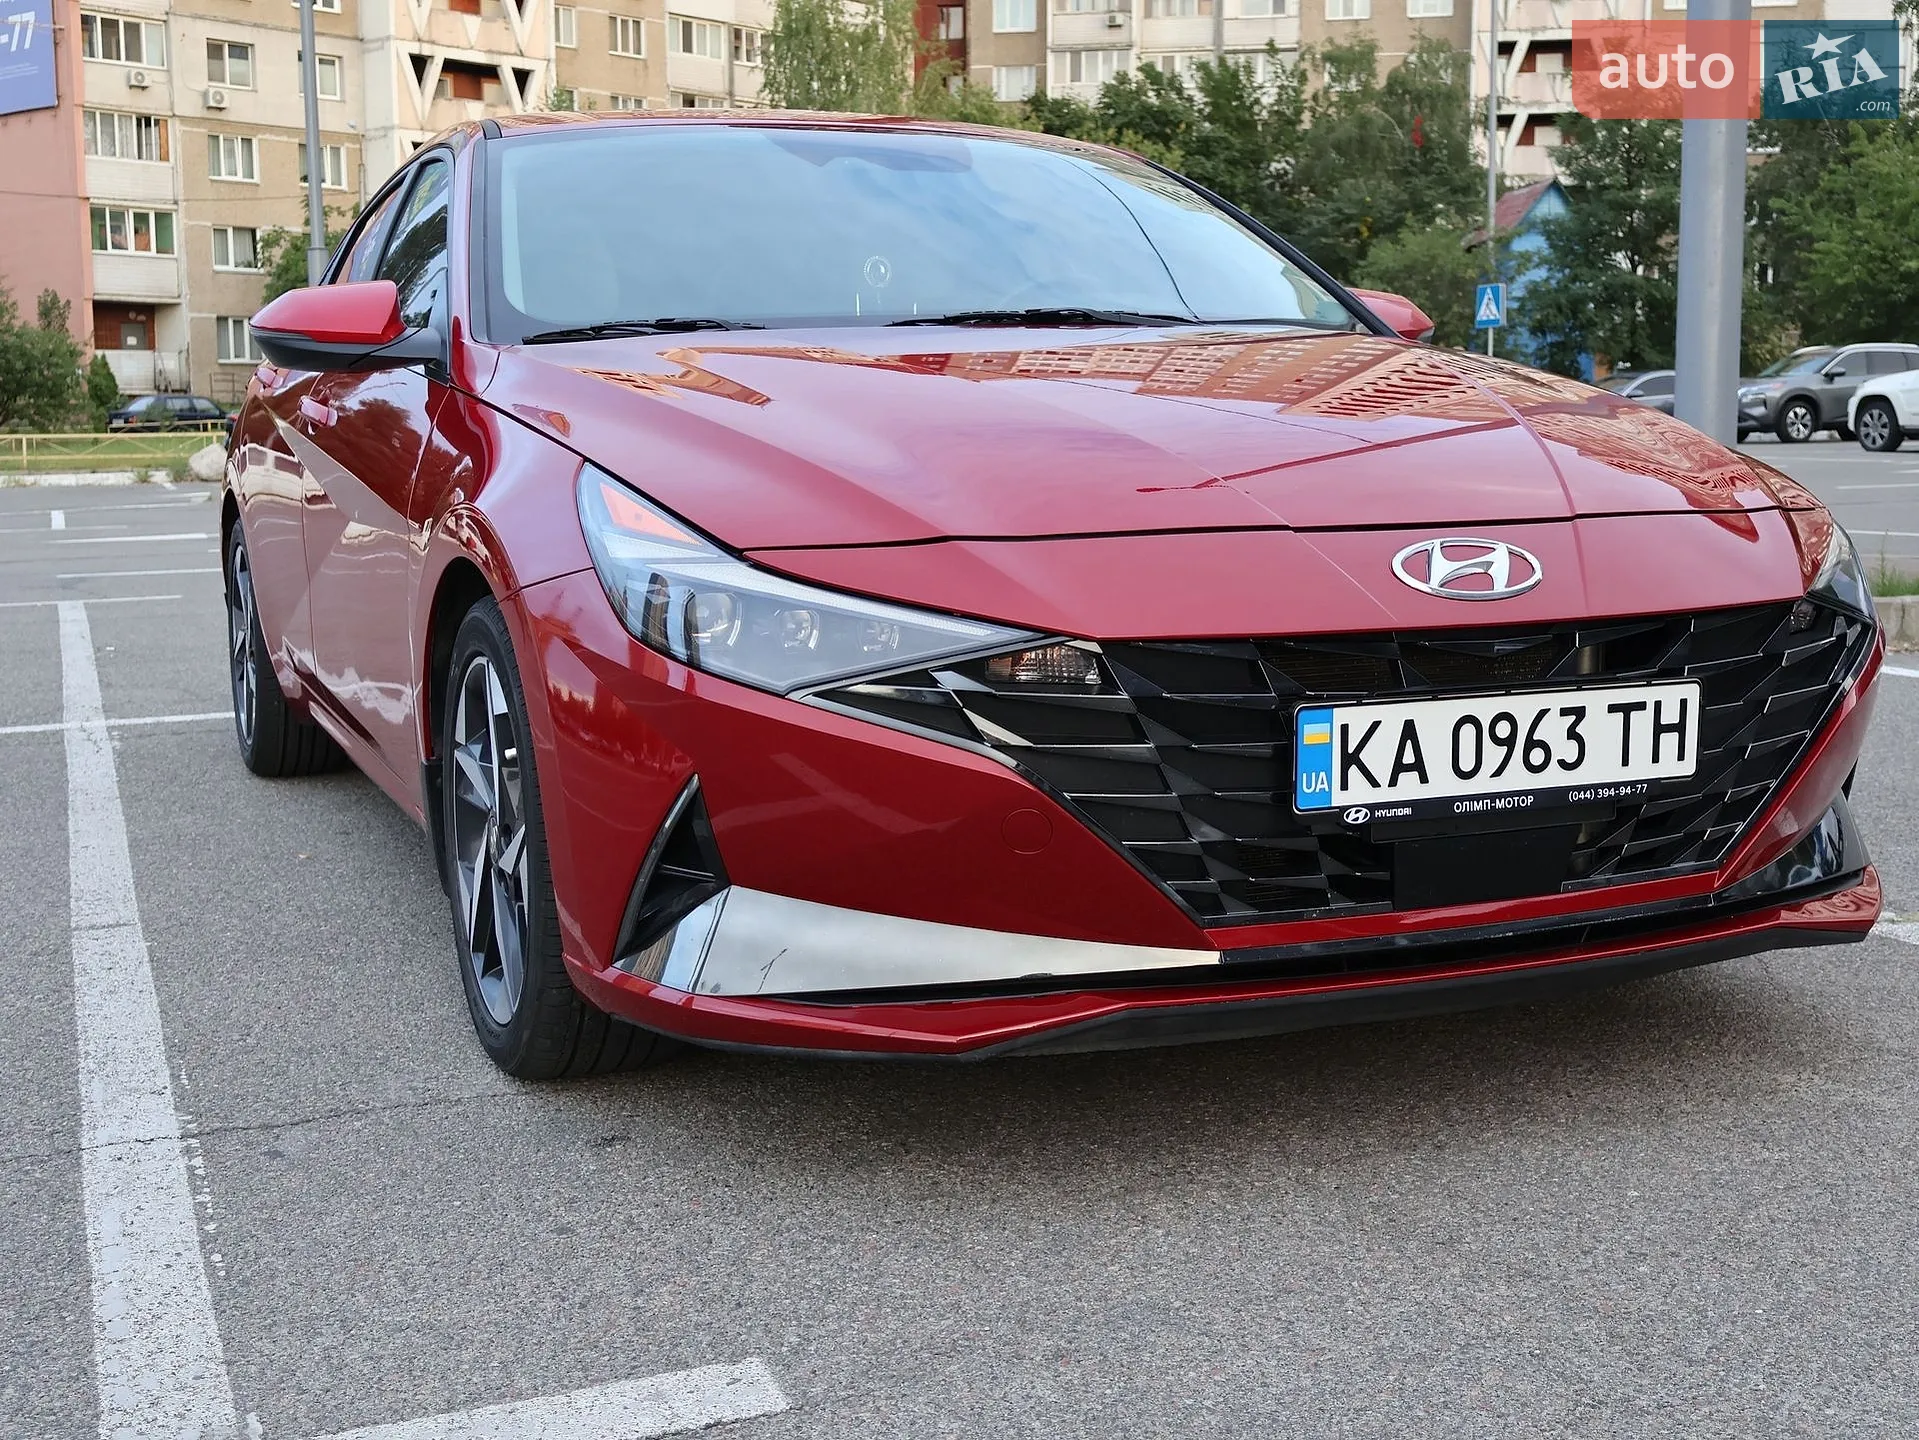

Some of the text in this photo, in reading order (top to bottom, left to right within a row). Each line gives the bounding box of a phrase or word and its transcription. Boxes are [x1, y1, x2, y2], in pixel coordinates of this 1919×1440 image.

[1339, 697, 1688, 791] KA 0963 TH
[1302, 771, 1329, 794] UA
[1568, 784, 1648, 803] (044) 394-94-77
[1374, 807, 1412, 818] HYUNDAI
[1453, 795, 1534, 813] ОЛІМП-МОТОР
